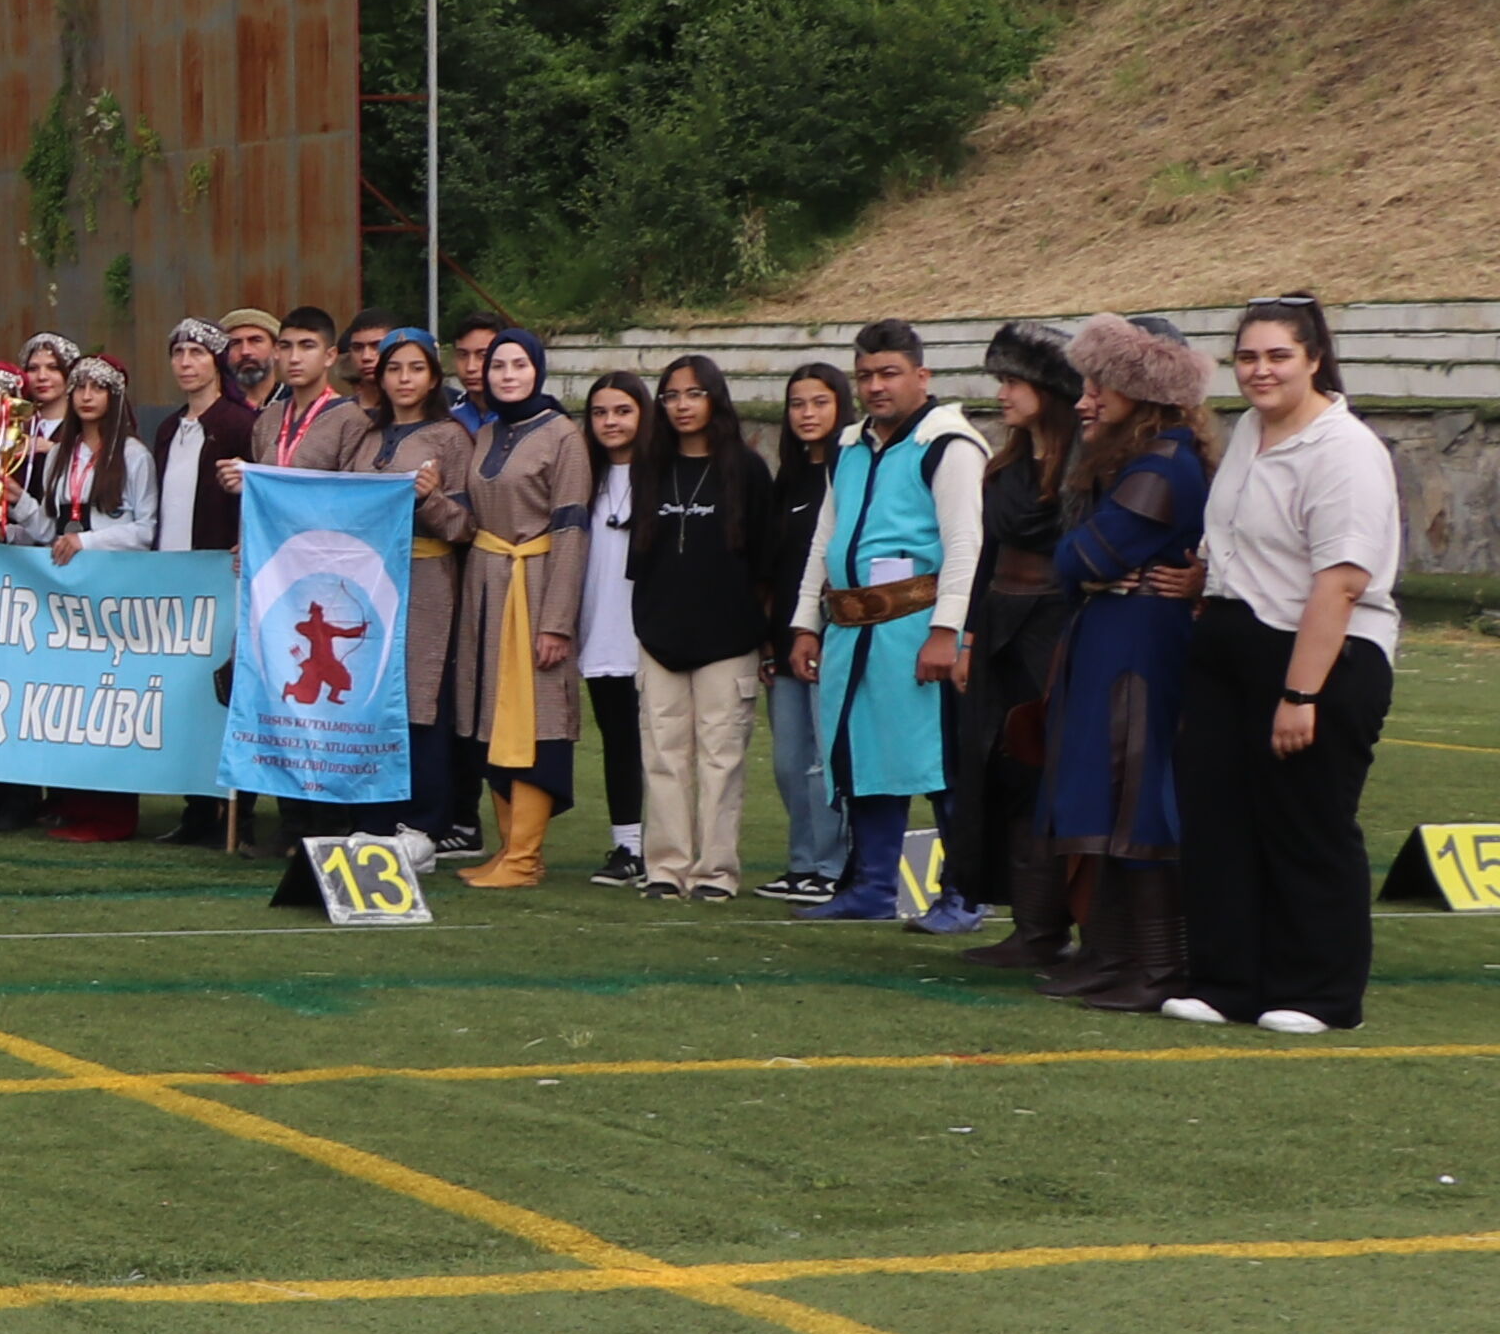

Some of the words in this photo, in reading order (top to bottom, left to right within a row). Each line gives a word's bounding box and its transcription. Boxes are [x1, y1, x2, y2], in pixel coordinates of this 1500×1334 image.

[47, 592, 216, 667] SELÇUKLU
[17, 673, 164, 750] KULÜBÜ
[322, 845, 414, 915] 13
[1437, 834, 1500, 902] 15
